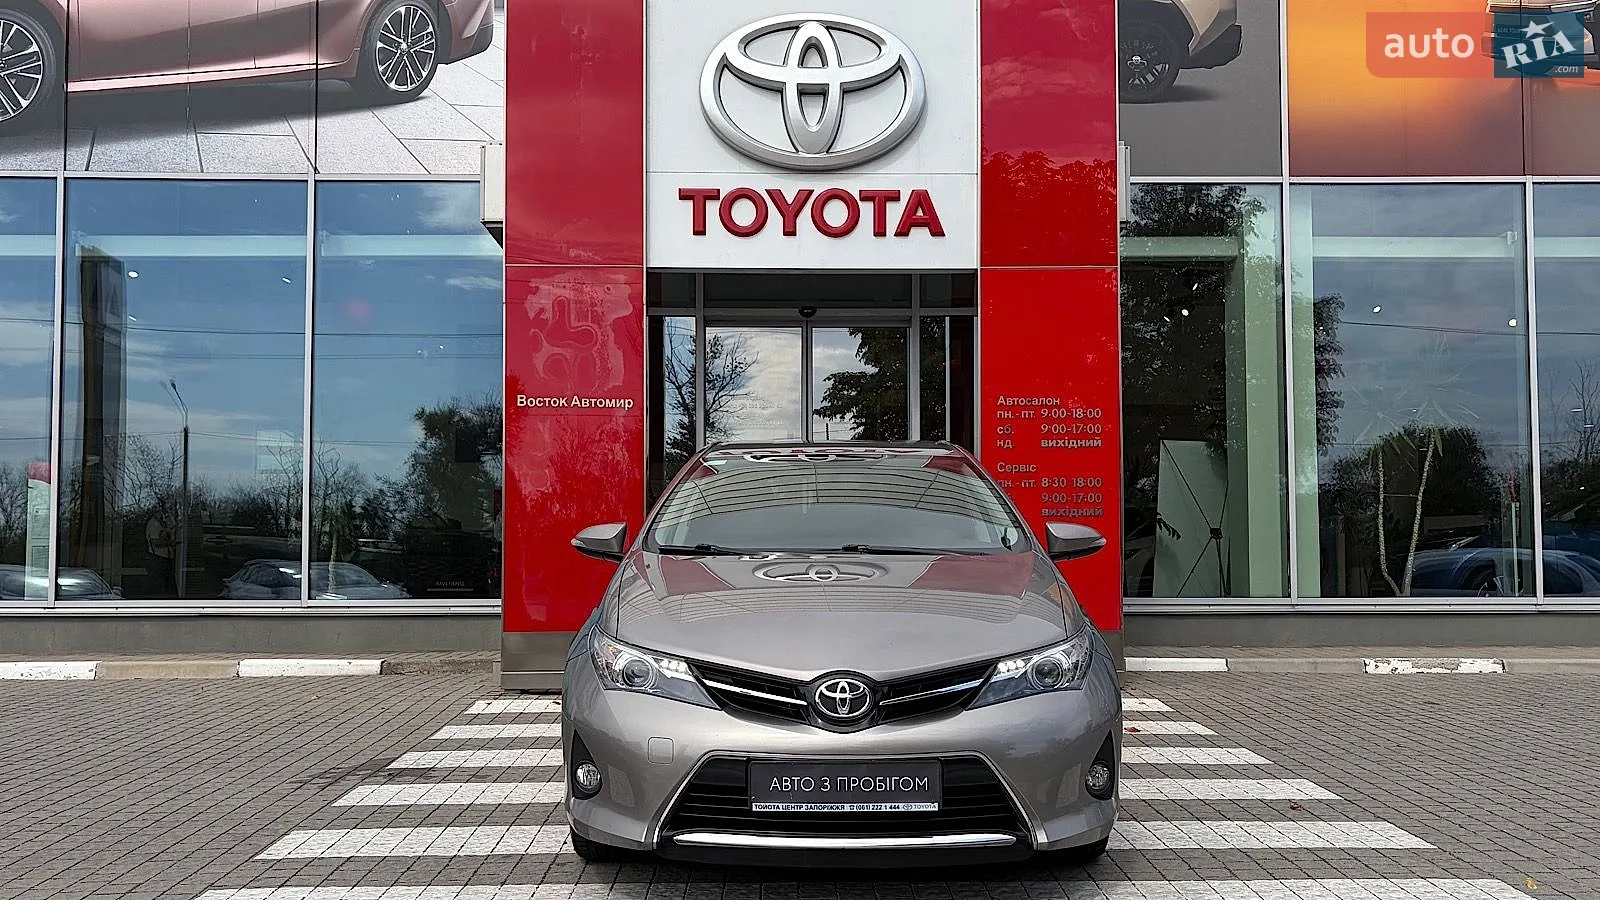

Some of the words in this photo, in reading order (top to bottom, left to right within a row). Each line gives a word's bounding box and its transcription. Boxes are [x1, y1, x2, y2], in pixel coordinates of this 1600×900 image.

[678, 187, 946, 238] TOYOTA
[516, 394, 569, 408] Восток
[570, 395, 634, 411] Автомир
[996, 395, 1061, 406] Автосалон
[1040, 408, 1102, 419] 9:00-18:00
[1040, 423, 1102, 434] 9:00-17:00
[1040, 437, 1102, 449] вихідний
[996, 461, 1037, 475] Сервіс
[1040, 493, 1103, 503] 9:00-17:00
[1041, 505, 1104, 518] вихідний
[769, 776, 815, 792] АВТО
[837, 776, 928, 792] ПРОБІГОМ
